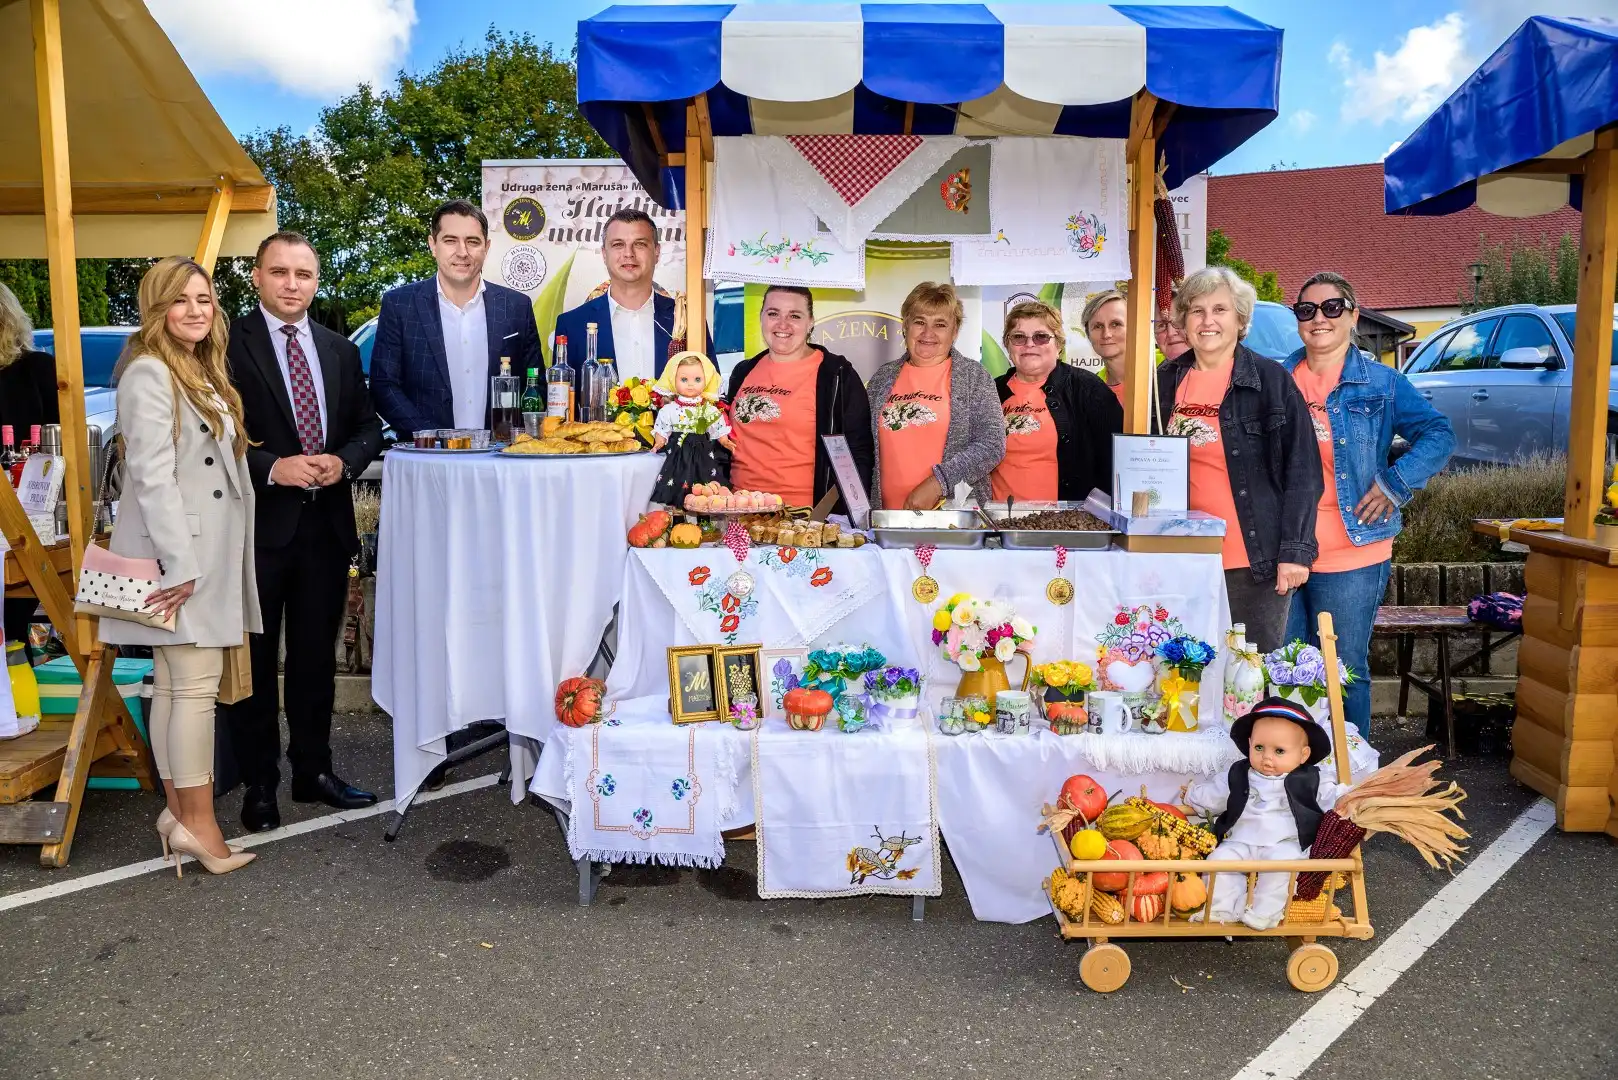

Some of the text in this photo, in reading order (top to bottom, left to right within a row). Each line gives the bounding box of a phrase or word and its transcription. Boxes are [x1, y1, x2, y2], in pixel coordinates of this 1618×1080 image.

[501, 183, 543, 194] Udruga
[545, 182, 573, 192] žena
[575, 182, 628, 191] «Maruša»
[837, 319, 889, 341] ŽENA
